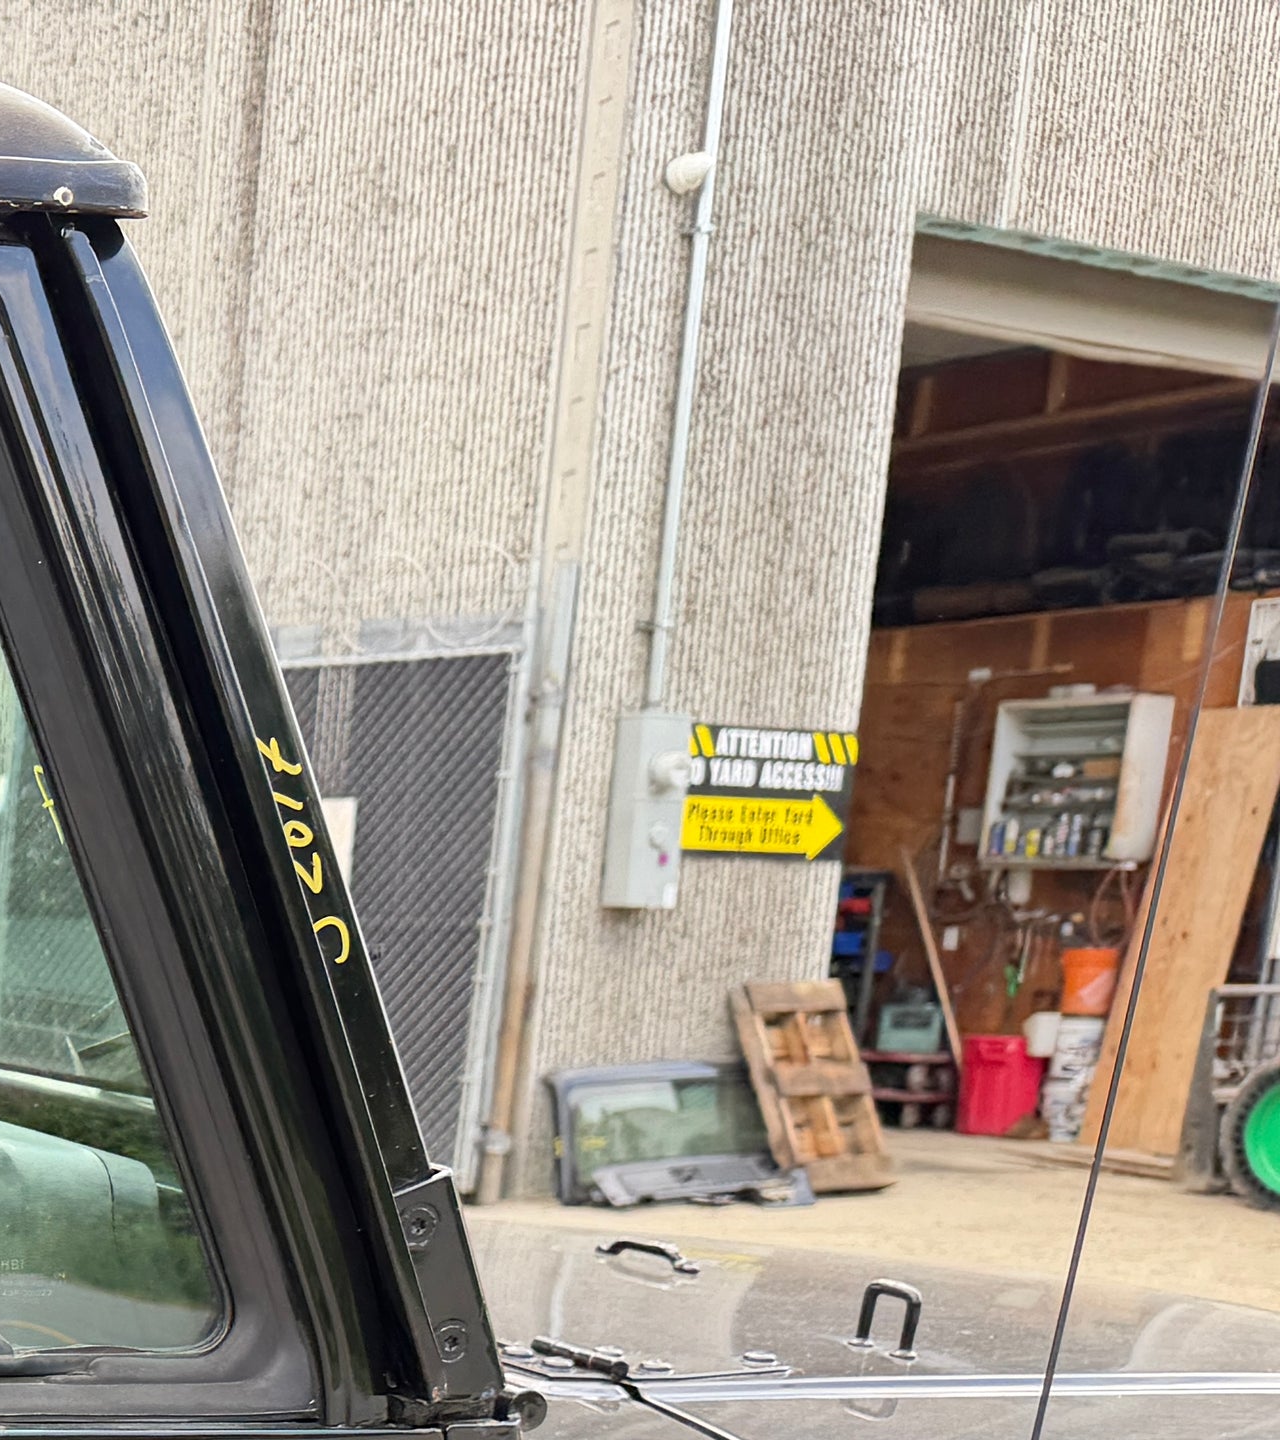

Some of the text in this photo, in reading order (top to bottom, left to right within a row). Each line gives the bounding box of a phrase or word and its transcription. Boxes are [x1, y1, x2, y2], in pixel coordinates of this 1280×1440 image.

[715, 727, 813, 761] ATTENTION
[690, 757, 845, 792] O YARD ACCESS!!!
[687, 802, 735, 822] Please
[255, 736, 351, 964] J2617
[698, 825, 801, 847] Through Office
